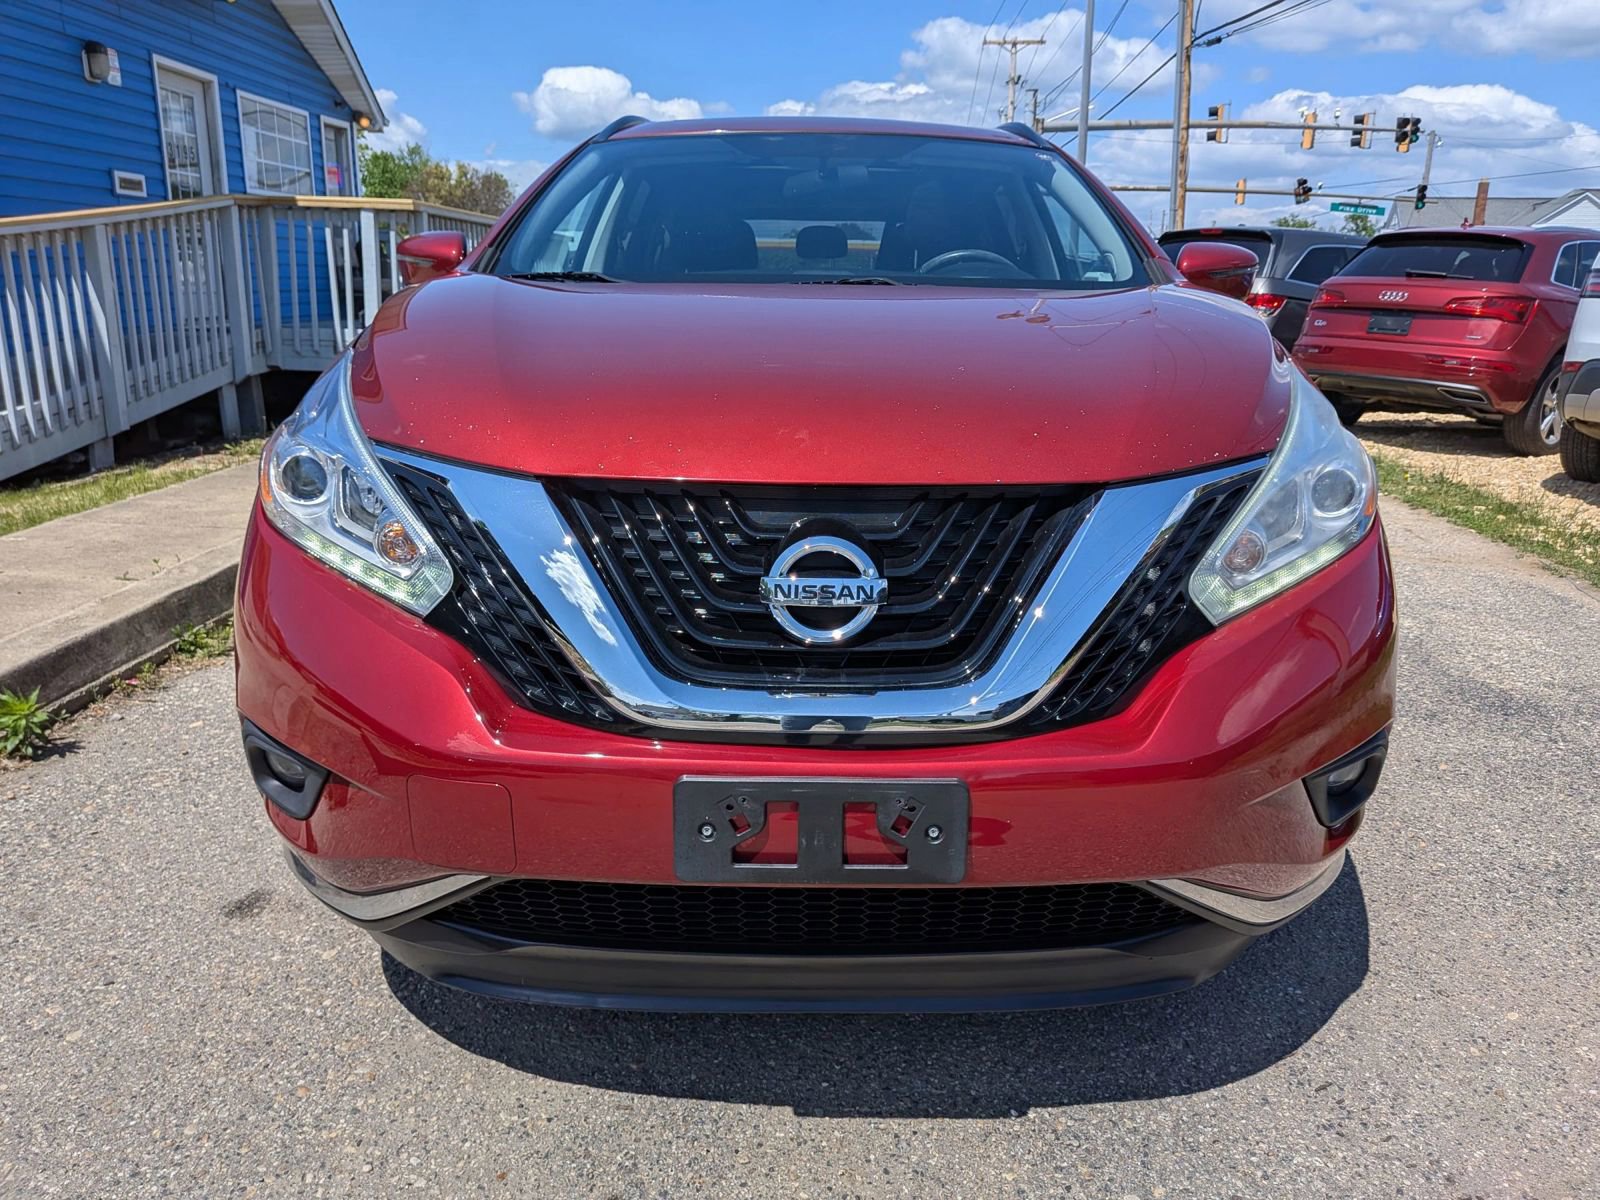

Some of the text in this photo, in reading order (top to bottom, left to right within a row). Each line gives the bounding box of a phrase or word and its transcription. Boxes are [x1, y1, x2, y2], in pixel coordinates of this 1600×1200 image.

[167, 141, 195, 161] 3195
[1357, 206, 1377, 214] Drive
[774, 583, 874, 600] NISSAN
